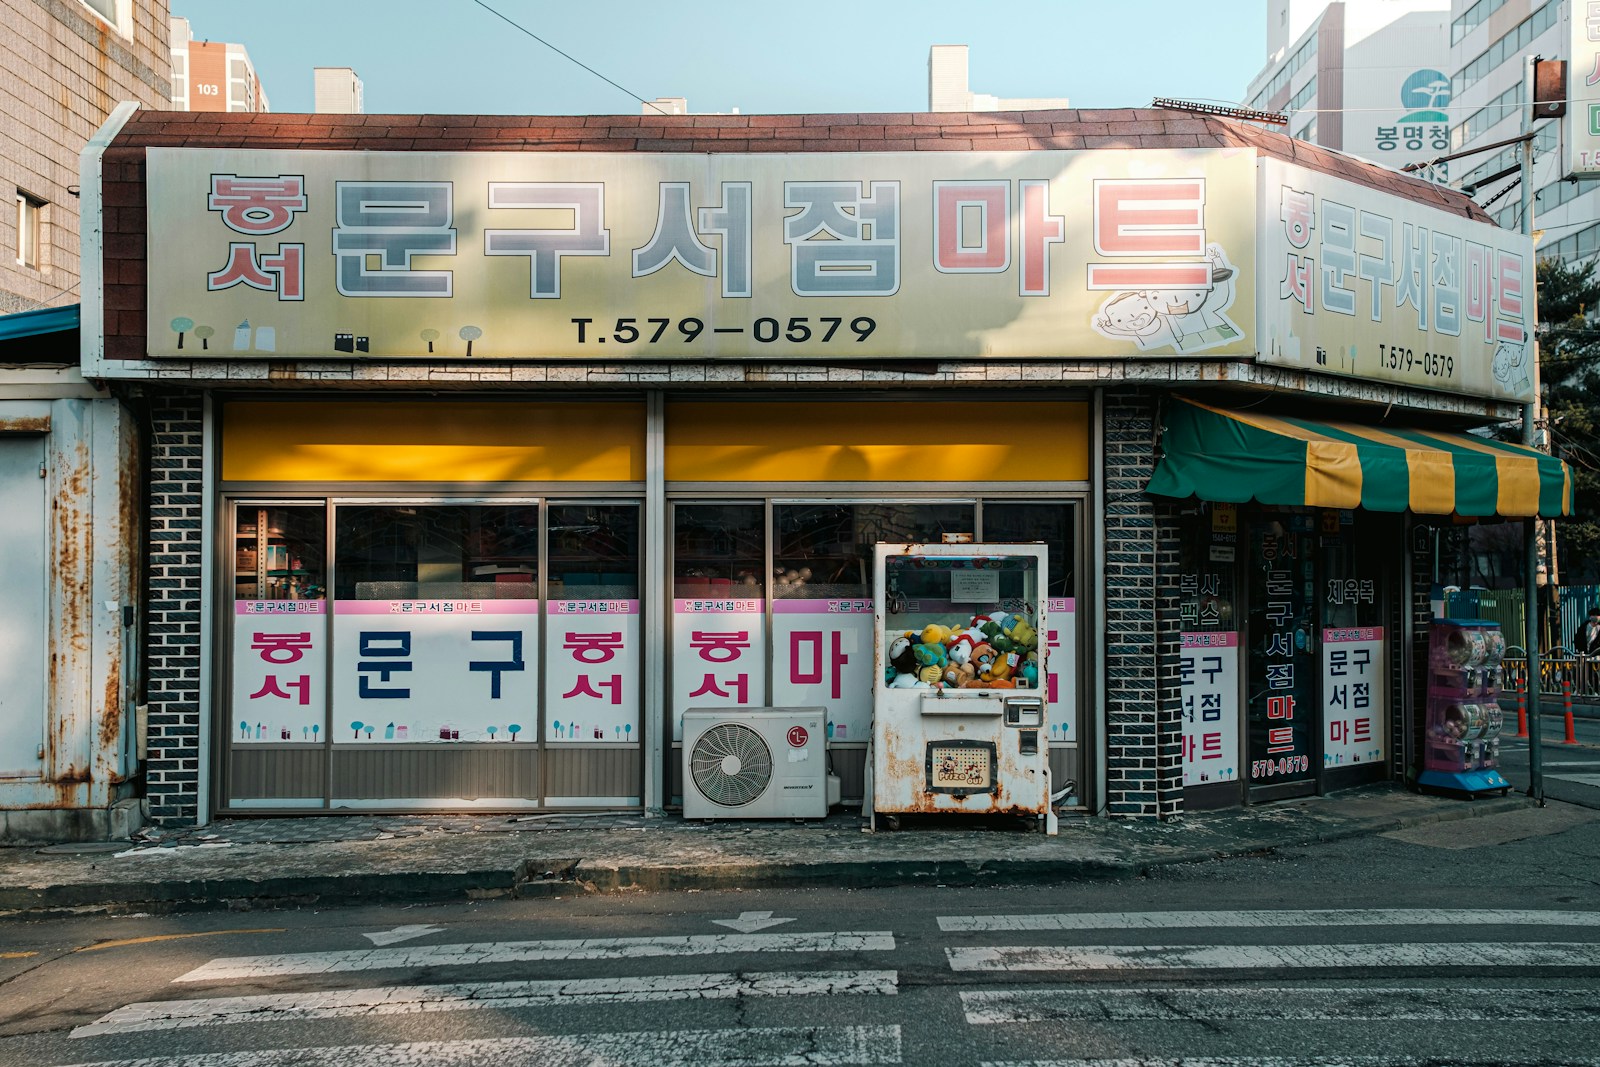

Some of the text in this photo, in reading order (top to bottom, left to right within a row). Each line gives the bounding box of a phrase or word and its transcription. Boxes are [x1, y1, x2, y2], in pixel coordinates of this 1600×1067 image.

[197, 83, 219, 96] 103
[1375, 125, 1448, 151] 봉명청
[207, 173, 1213, 302] 봉서 문구서점마트
[1280, 184, 1525, 345] 봉서 문구서점마트
[571, 316, 877, 344] T.579-0579
[1378, 343, 1455, 379] T.579-0579
[1180, 574, 1221, 597] 복사
[1327, 578, 1374, 605] 체육복
[255, 601, 319, 613] 문구서점마트
[401, 601, 482, 613] 문구서점마트
[567, 601, 630, 613] 문구서점마트
[694, 601, 756, 612] 문구서점마트
[1180, 602, 1220, 626] 팩스
[250, 632, 313, 705] 봉서
[562, 632, 624, 704] 봉서
[689, 631, 750, 704] 봉서
[790, 631, 848, 699] 마
[1329, 649, 1371, 676] 문구
[1330, 682, 1370, 709] 서점
[1330, 717, 1371, 745] 마트
[1252, 754, 1309, 779] 579-0579
